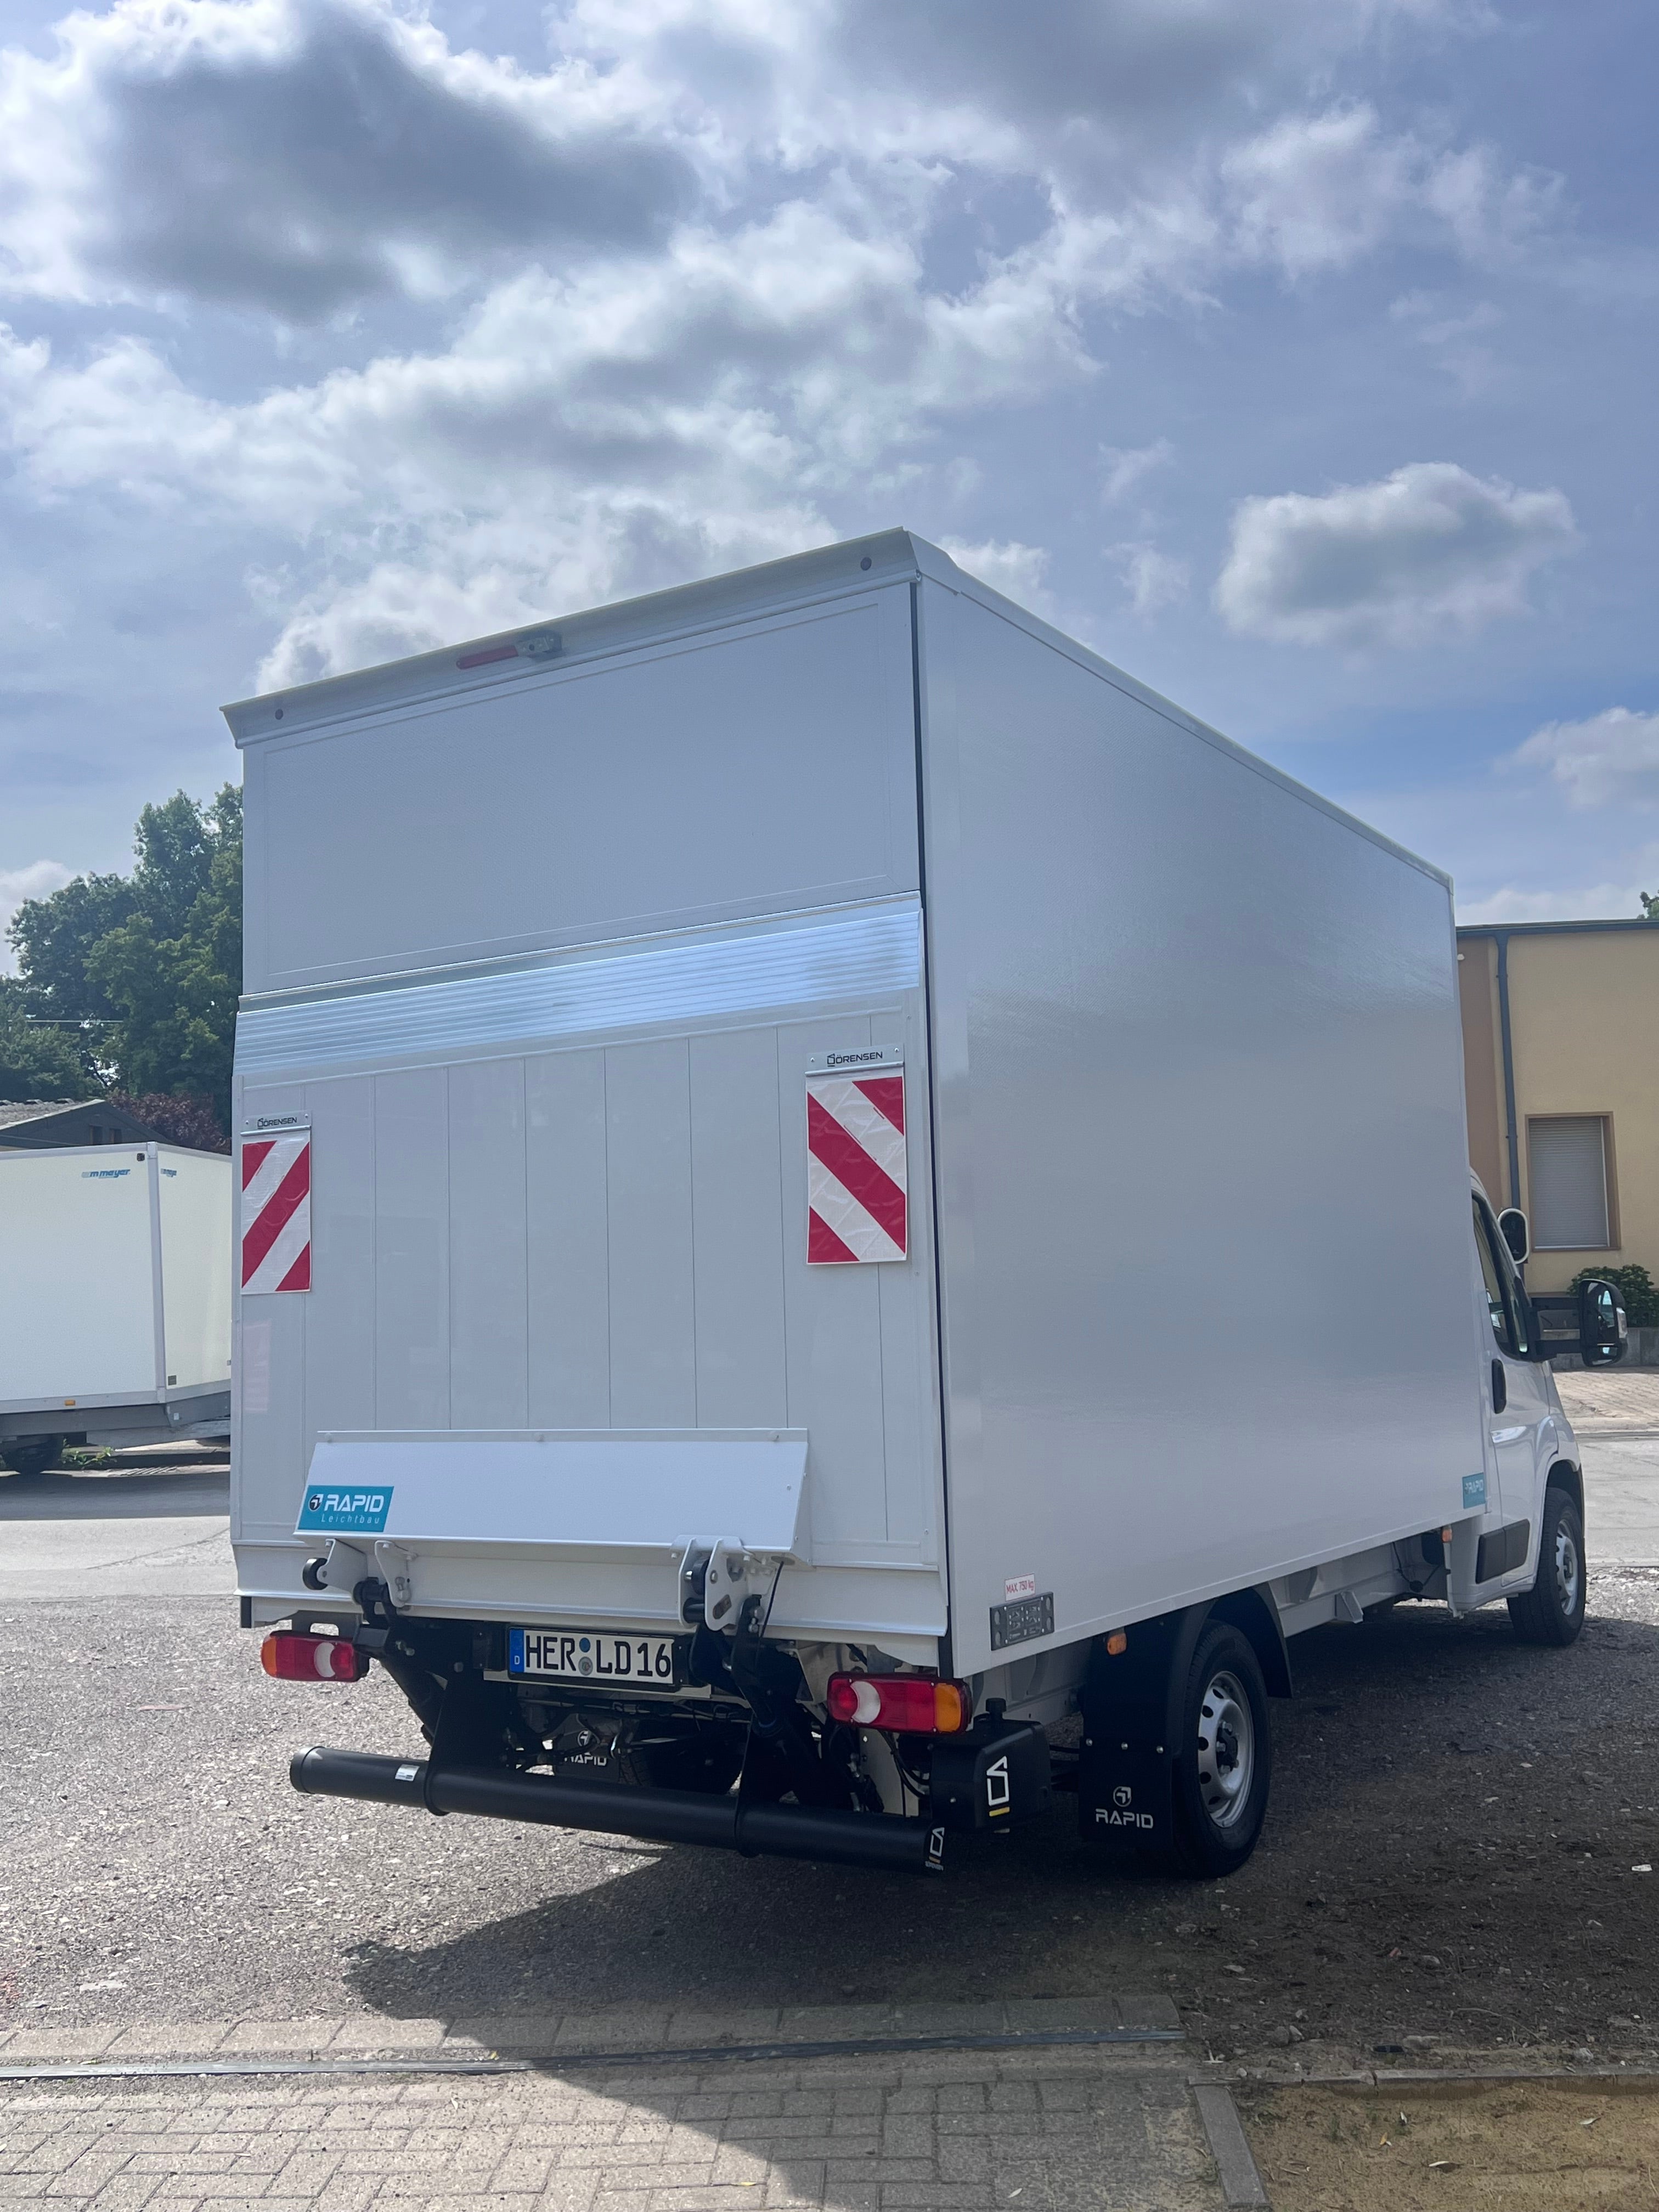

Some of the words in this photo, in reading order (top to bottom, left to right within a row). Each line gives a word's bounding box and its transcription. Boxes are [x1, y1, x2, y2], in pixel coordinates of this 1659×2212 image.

[827, 1051, 883, 1066] SÖRENSEN
[324, 1494, 385, 1513] RAPID
[321, 1514, 380, 1524] Leichtbau
[514, 1655, 520, 1665] D
[526, 1635, 577, 1672] HER
[1095, 1808, 1154, 1829] RAPID
